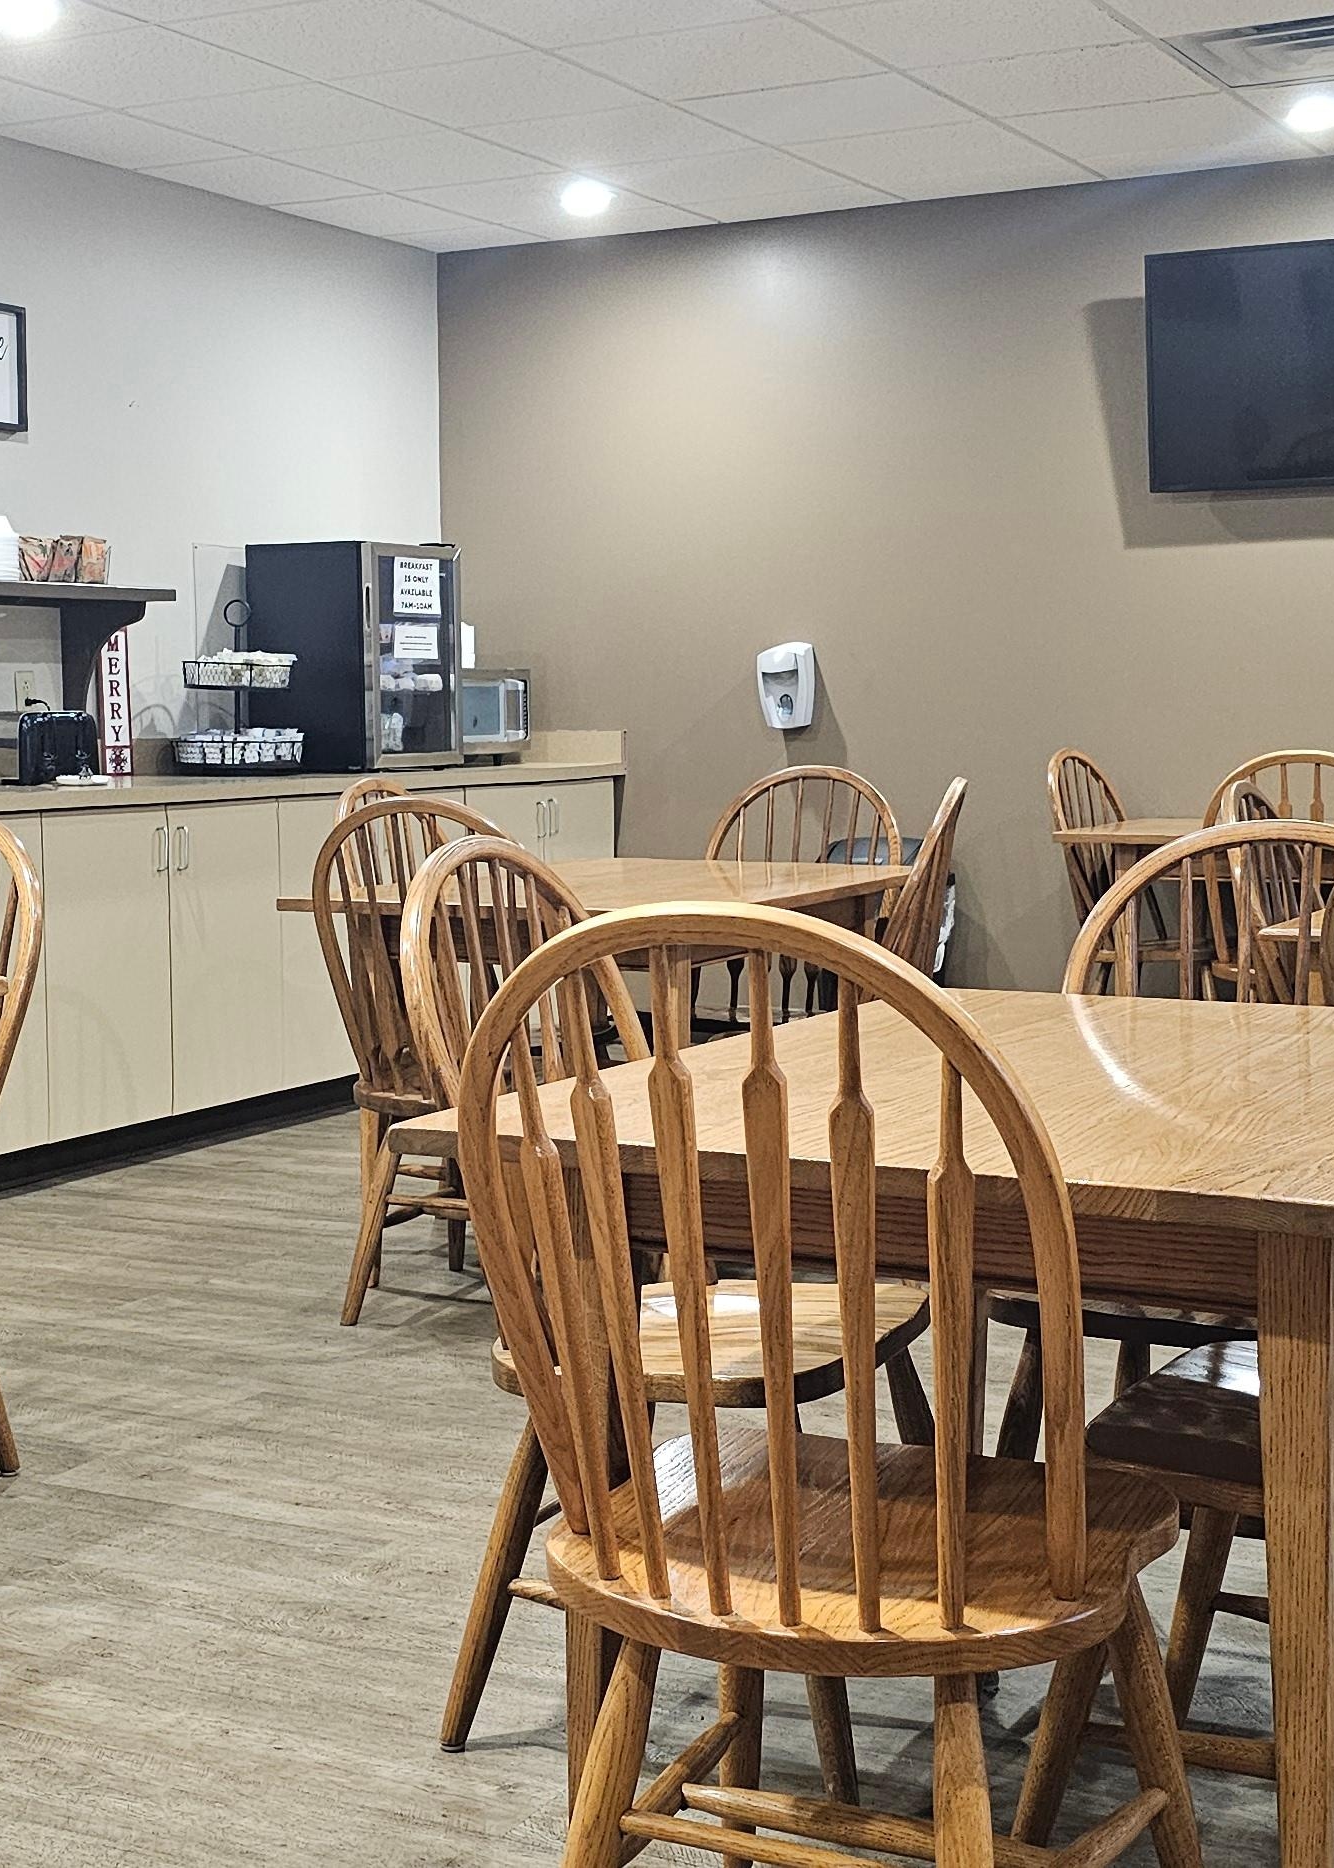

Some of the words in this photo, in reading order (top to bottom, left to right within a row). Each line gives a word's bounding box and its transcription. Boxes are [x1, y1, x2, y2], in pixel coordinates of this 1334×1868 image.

[400, 562, 433, 570] BREAKFAST
[400, 589, 433, 597] AVAILABLE
[107, 635, 122, 742] MERRY
